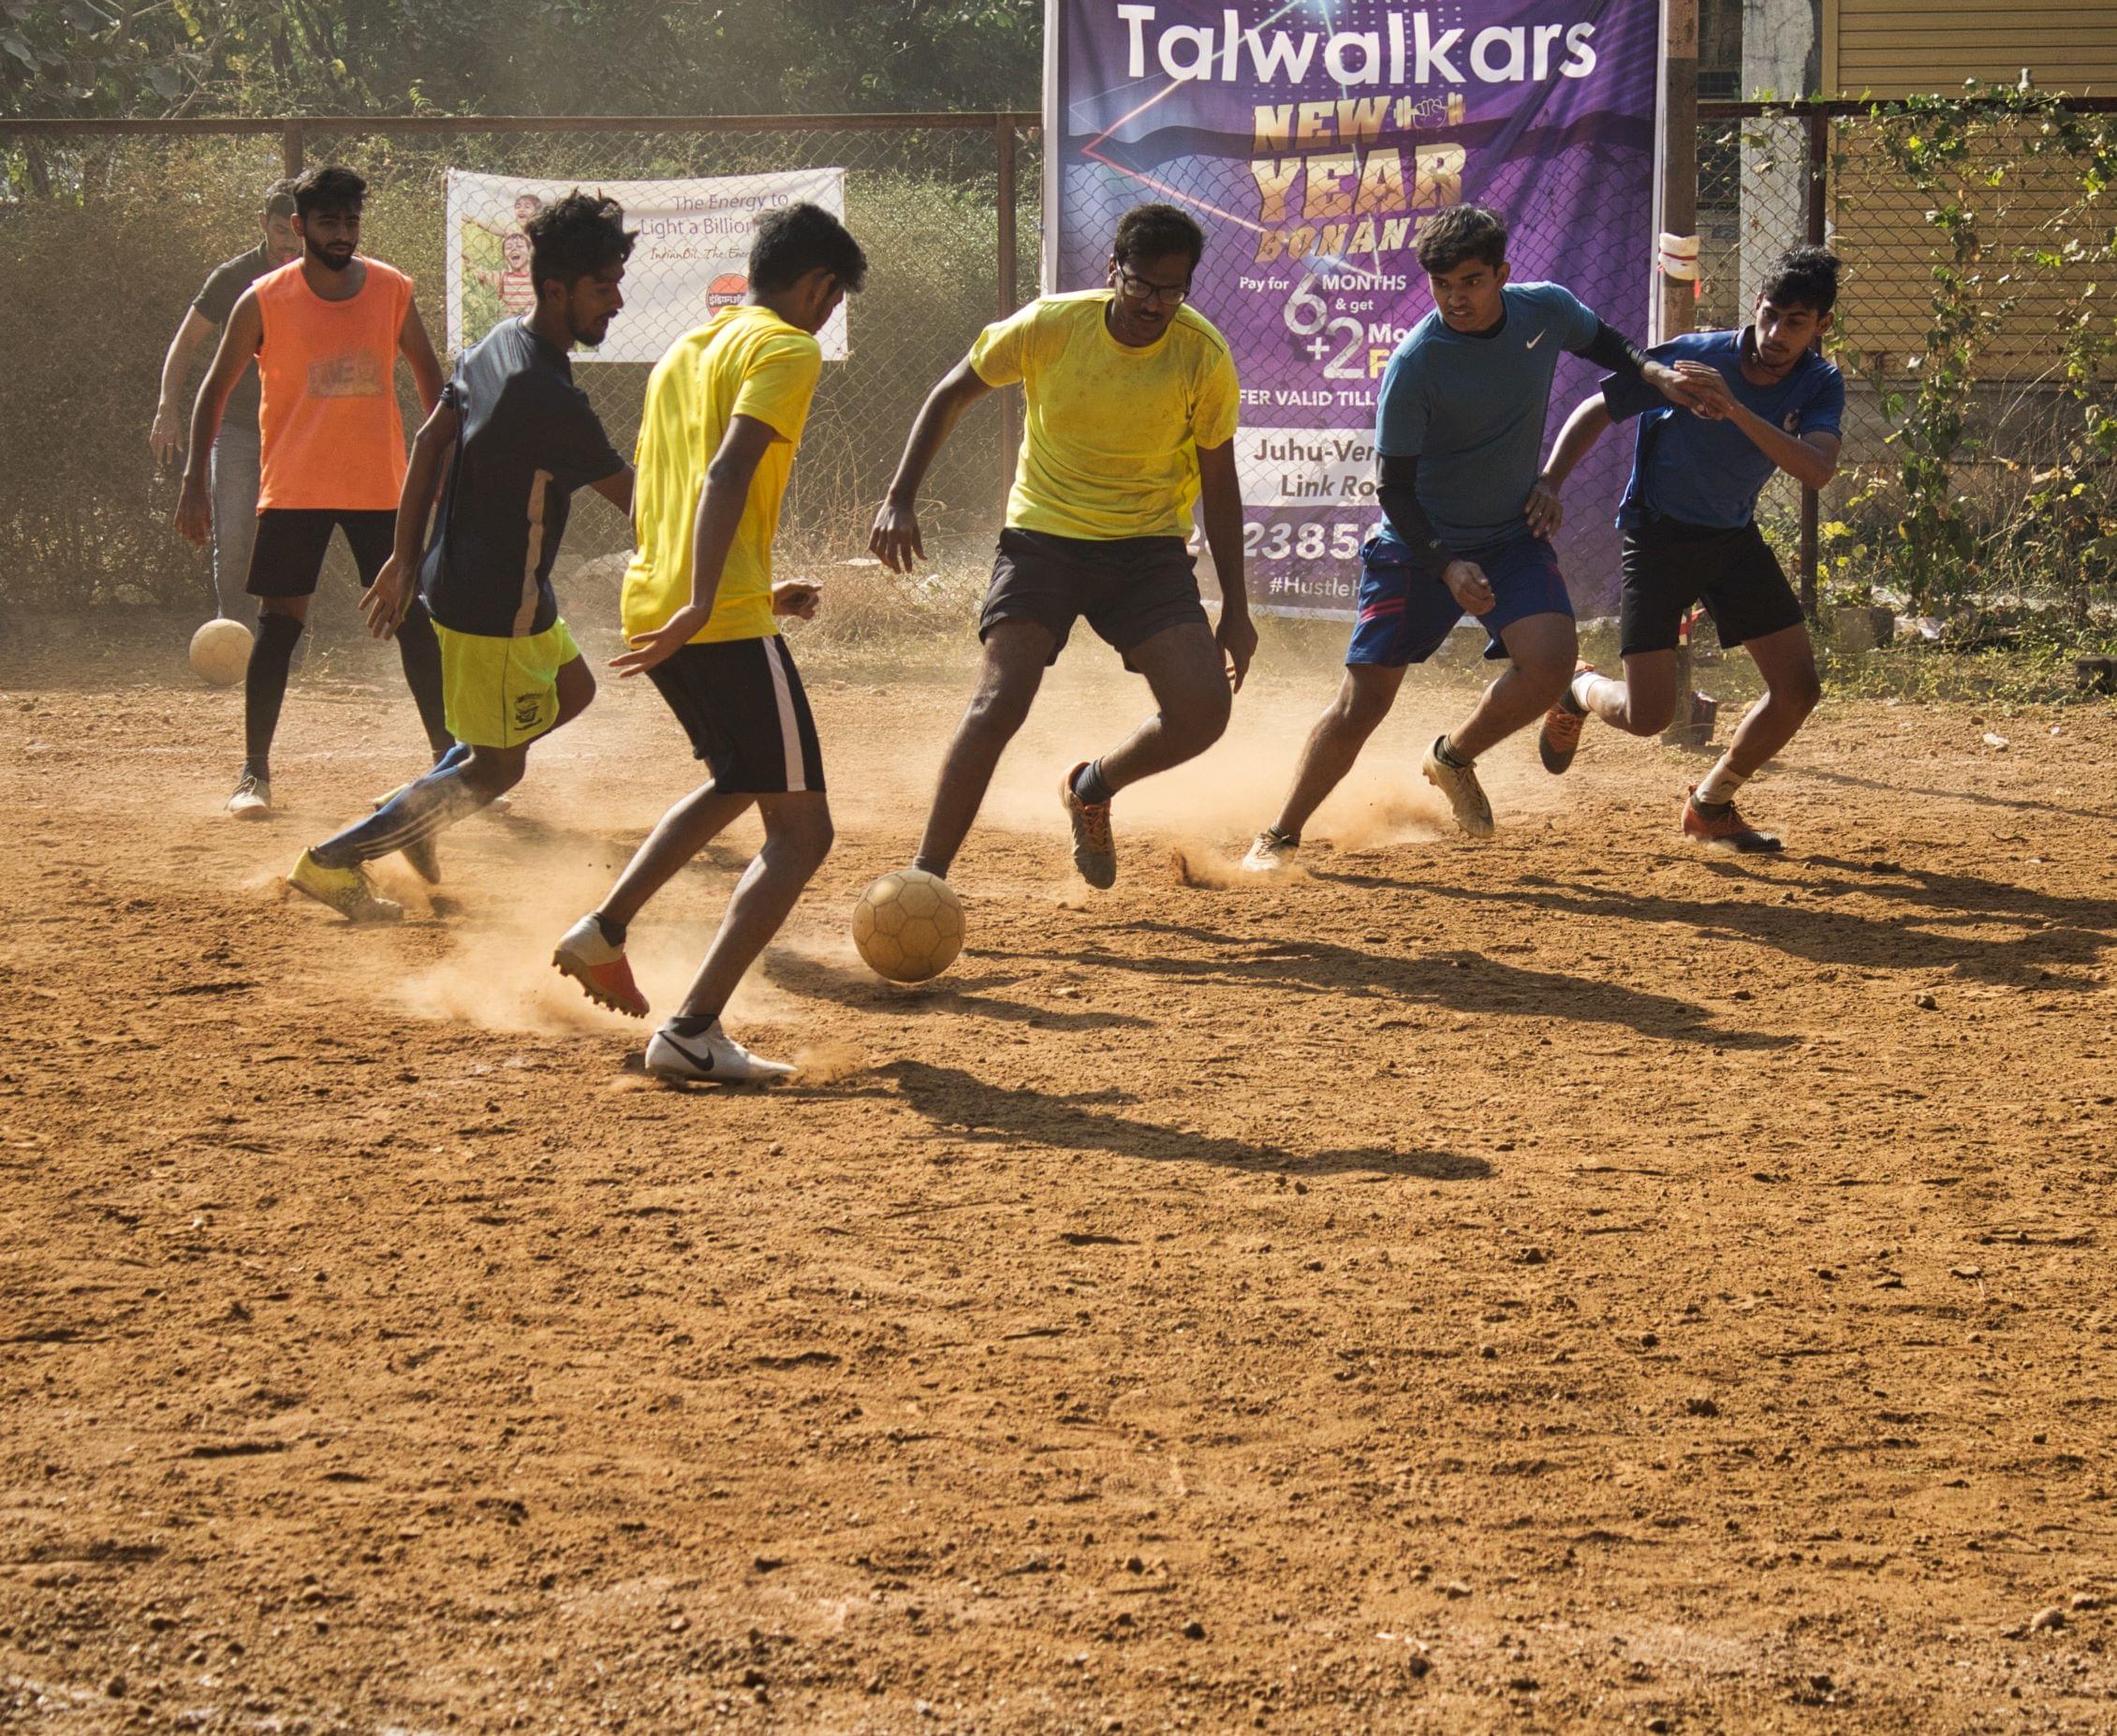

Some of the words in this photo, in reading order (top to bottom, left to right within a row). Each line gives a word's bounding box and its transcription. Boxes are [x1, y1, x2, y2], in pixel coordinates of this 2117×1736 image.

[1117, 4, 1597, 86] Talwalkars
[1253, 96, 1392, 154] NEW
[1251, 142, 1467, 223] YEAR
[673, 195, 704, 211] The
[709, 194, 766, 212] Energy
[772, 194, 788, 207] to
[640, 218, 684, 239] Light
[689, 223, 698, 234] a
[703, 246, 725, 259] The
[728, 246, 749, 259] Ener
[1240, 277, 1265, 292] Pay
[1268, 276, 1289, 289] for
[1284, 272, 1328, 335] 6
[1322, 274, 1406, 290] MONTHS
[1335, 298, 1346, 311] &
[1349, 299, 1374, 313] get
[1368, 323, 1407, 344] Mo
[1240, 390, 1271, 405] FER
[1275, 390, 1332, 406] VALID
[1337, 391, 1375, 406] TILL
[1254, 438, 1377, 463] Juhu-Ver
[1282, 475, 1335, 497] Link
[1340, 476, 1375, 497] Ro
